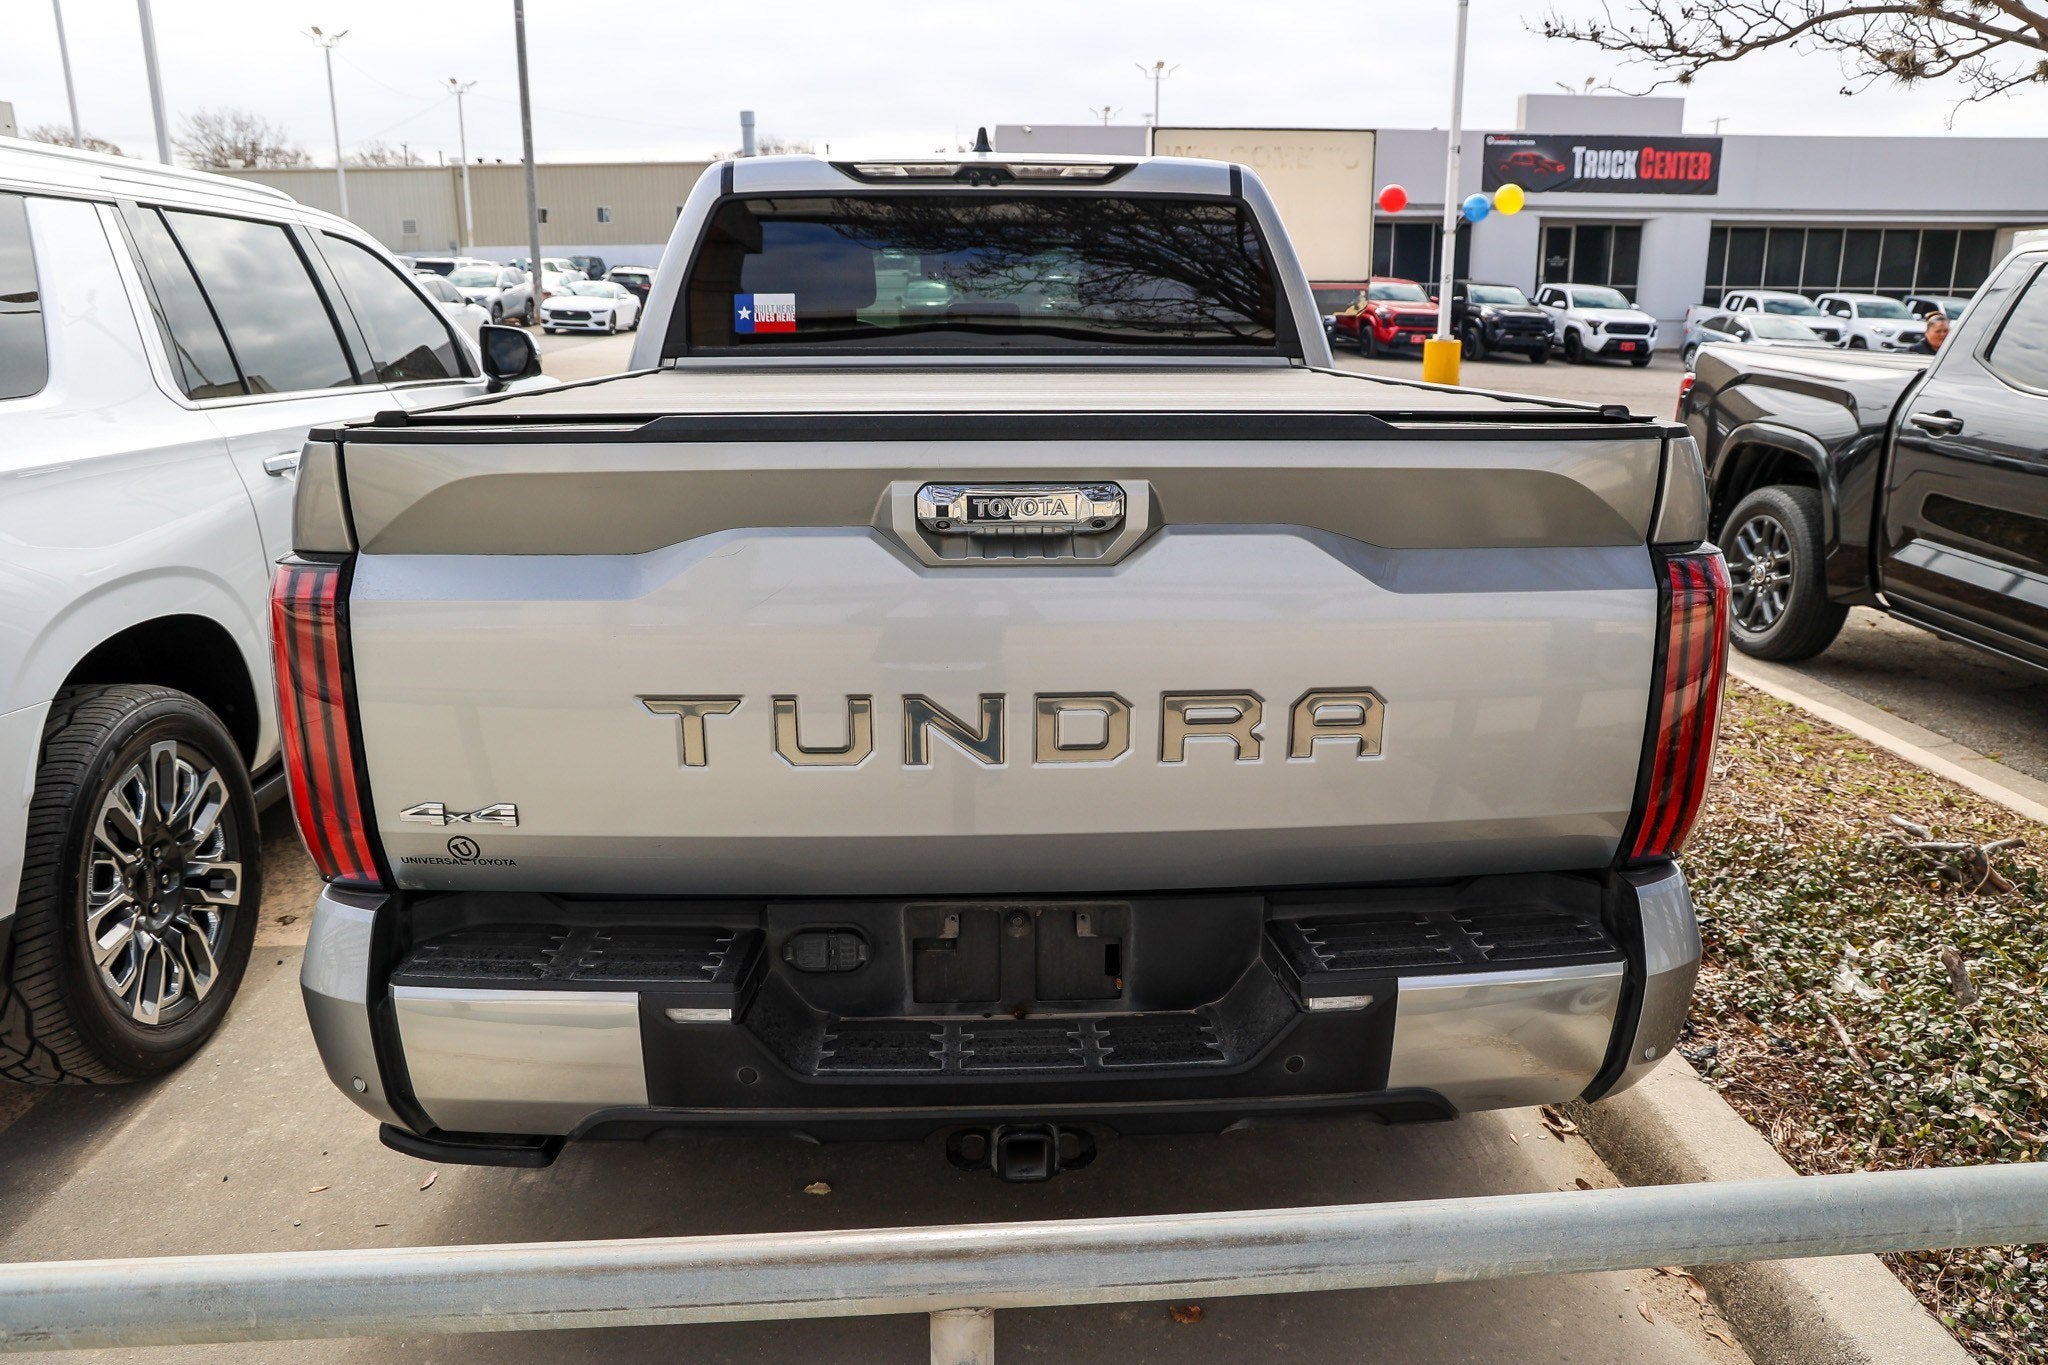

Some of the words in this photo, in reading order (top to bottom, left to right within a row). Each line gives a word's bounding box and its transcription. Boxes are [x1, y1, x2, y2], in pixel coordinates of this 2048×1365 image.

[1572, 146, 1638, 179] TRUCK
[1640, 146, 1712, 181] CENTER
[754, 304, 775, 313] BUILT
[776, 304, 795, 313] HERE
[754, 313, 775, 322] LIVES
[776, 313, 796, 322] HERE
[973, 498, 1068, 517] TOYOTA
[635, 687, 1388, 768] TUNDRA
[399, 801, 519, 827] 4x4
[401, 856, 468, 866] UNIVERSAL
[472, 858, 518, 867] TOYOTA
